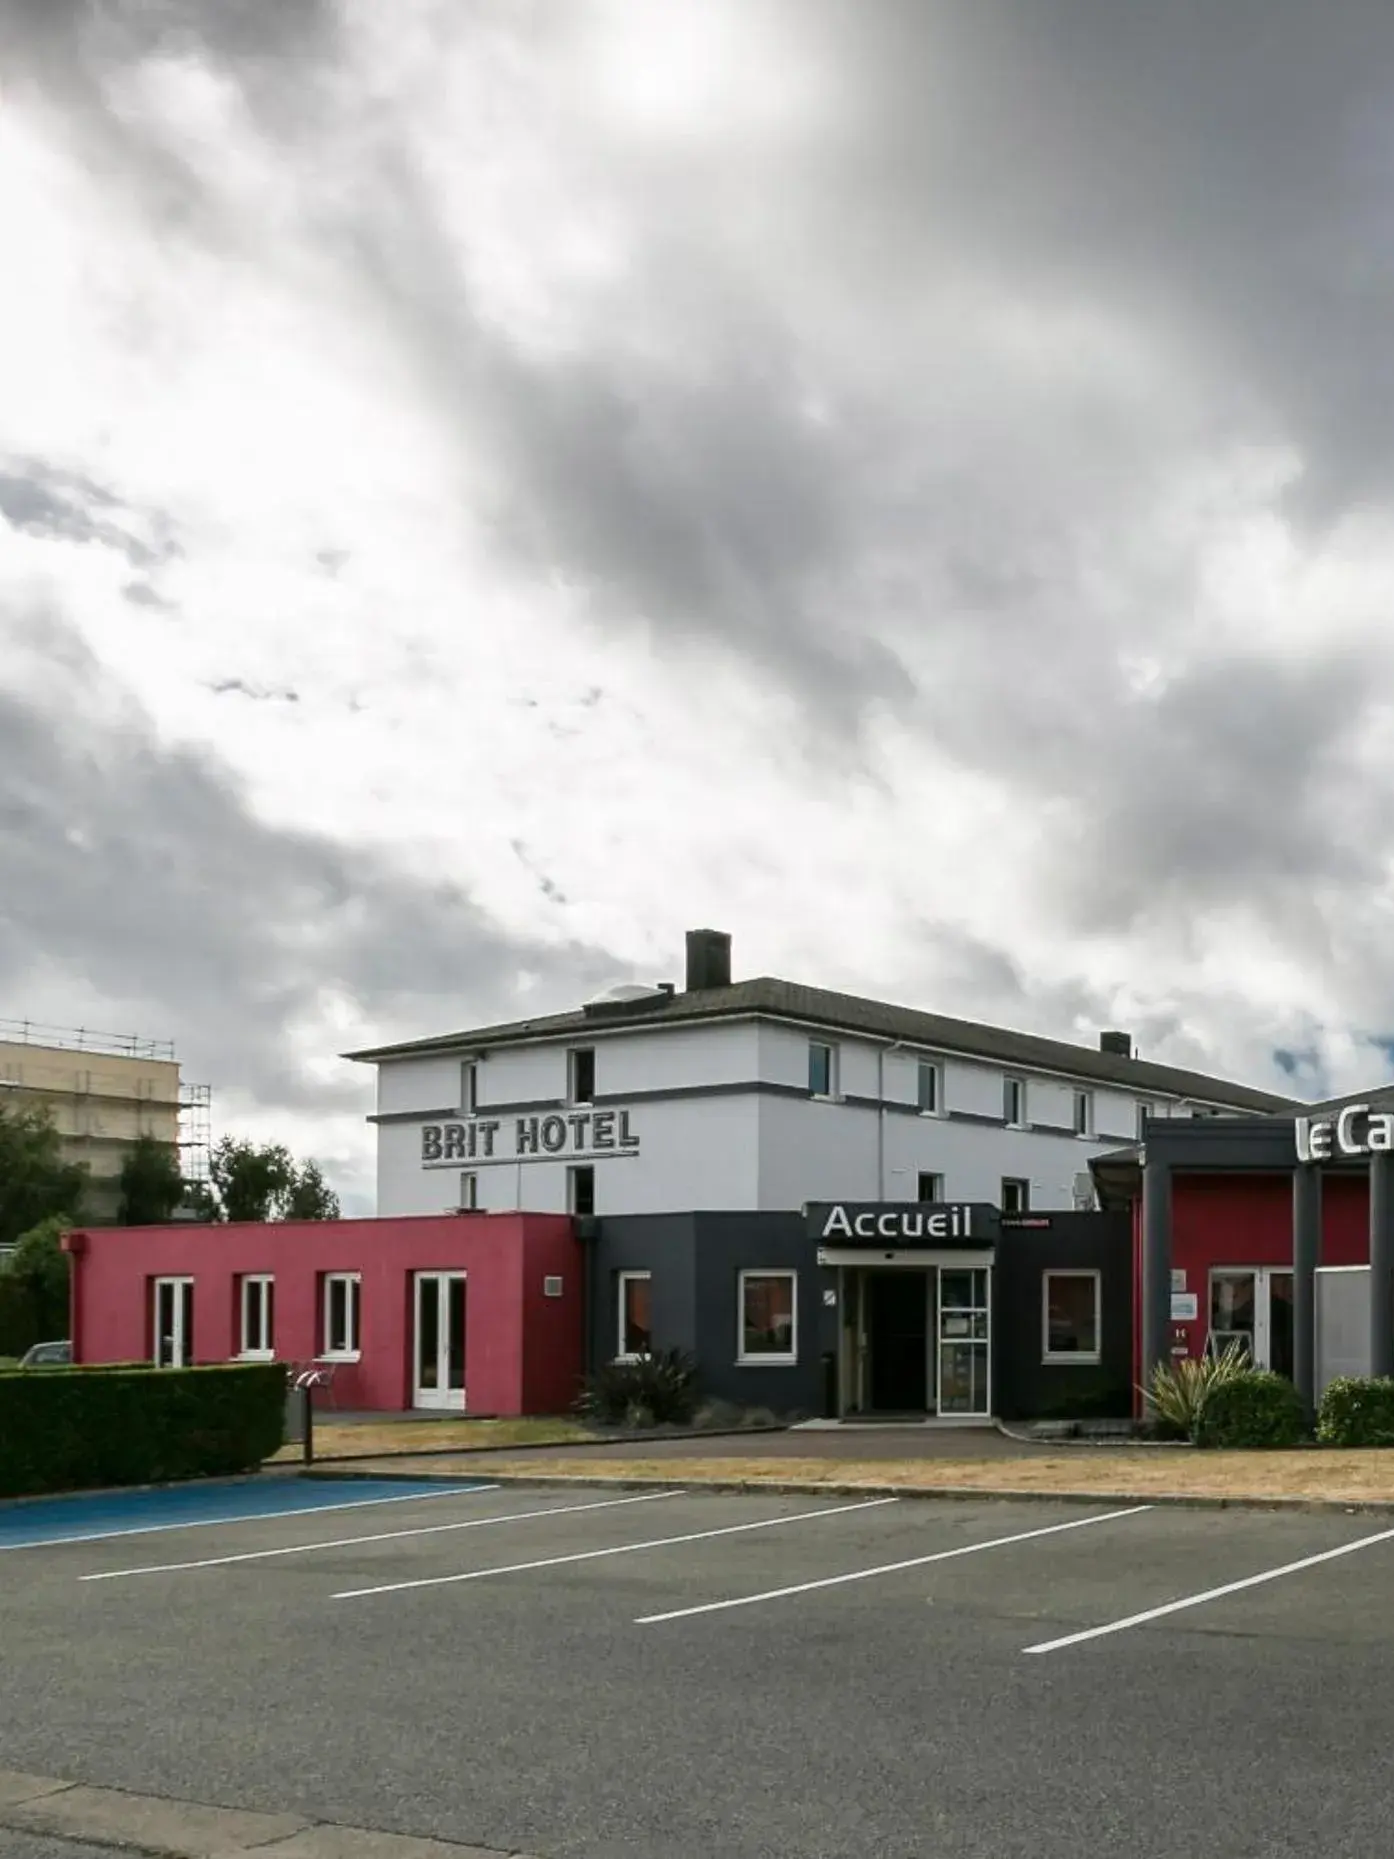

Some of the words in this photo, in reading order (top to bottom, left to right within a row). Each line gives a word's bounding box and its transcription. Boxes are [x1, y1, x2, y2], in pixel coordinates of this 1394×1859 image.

[421, 1120, 499, 1161] BRIT
[516, 1111, 640, 1154] HOTEL
[822, 1206, 971, 1237] Accueil
